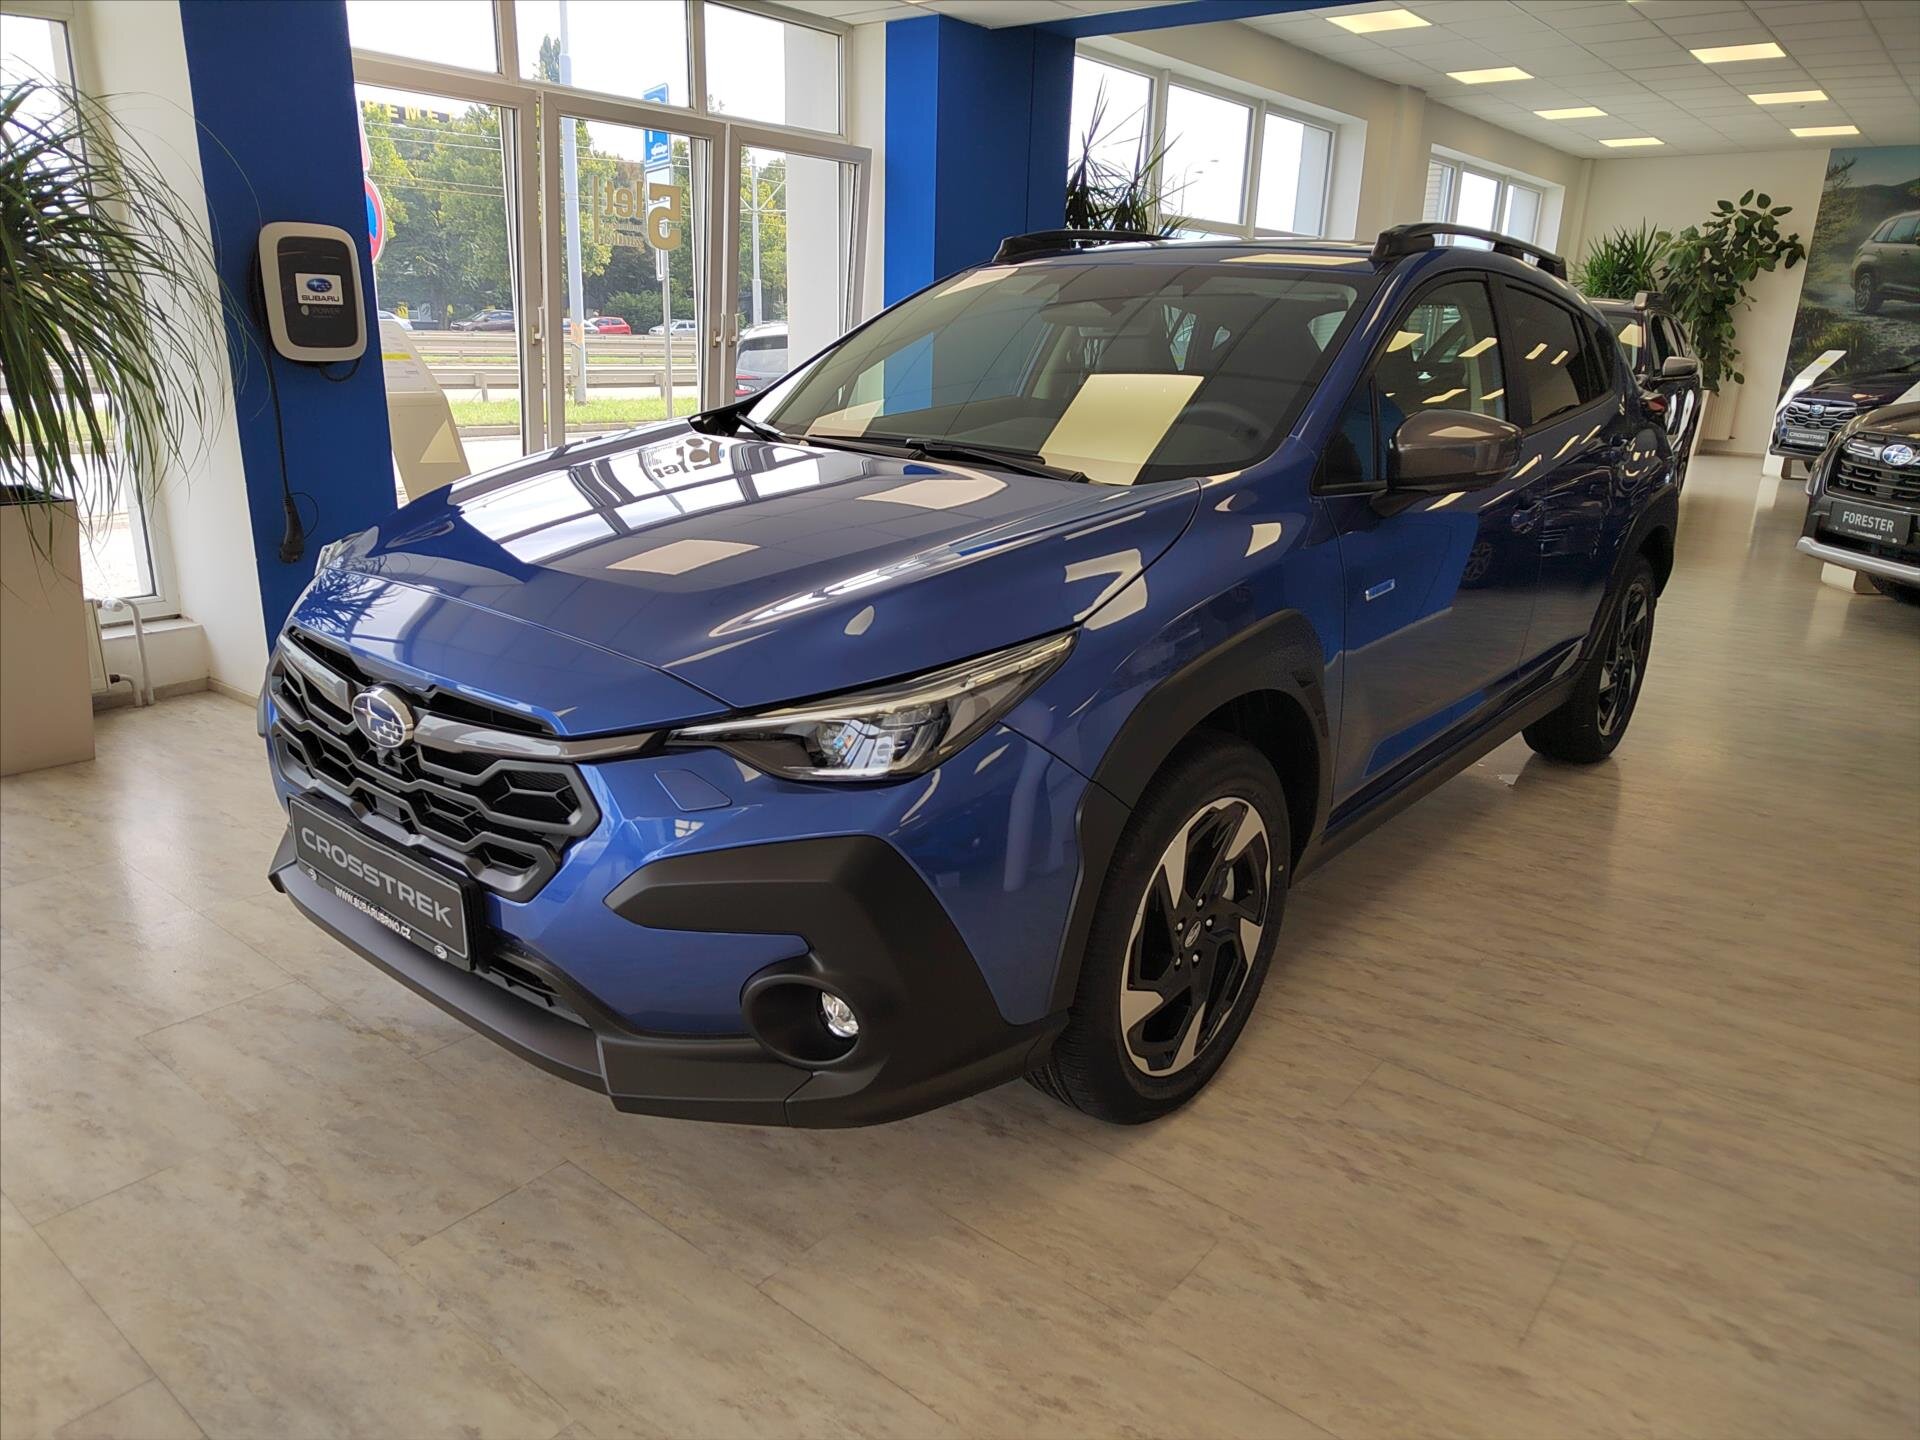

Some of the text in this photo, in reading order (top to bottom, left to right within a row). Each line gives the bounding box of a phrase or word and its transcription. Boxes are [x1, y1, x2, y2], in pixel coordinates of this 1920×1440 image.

[301, 294, 340, 303] SUBARU
[1842, 510, 1895, 533] FORESTER
[301, 827, 453, 929] CROSSTREK
